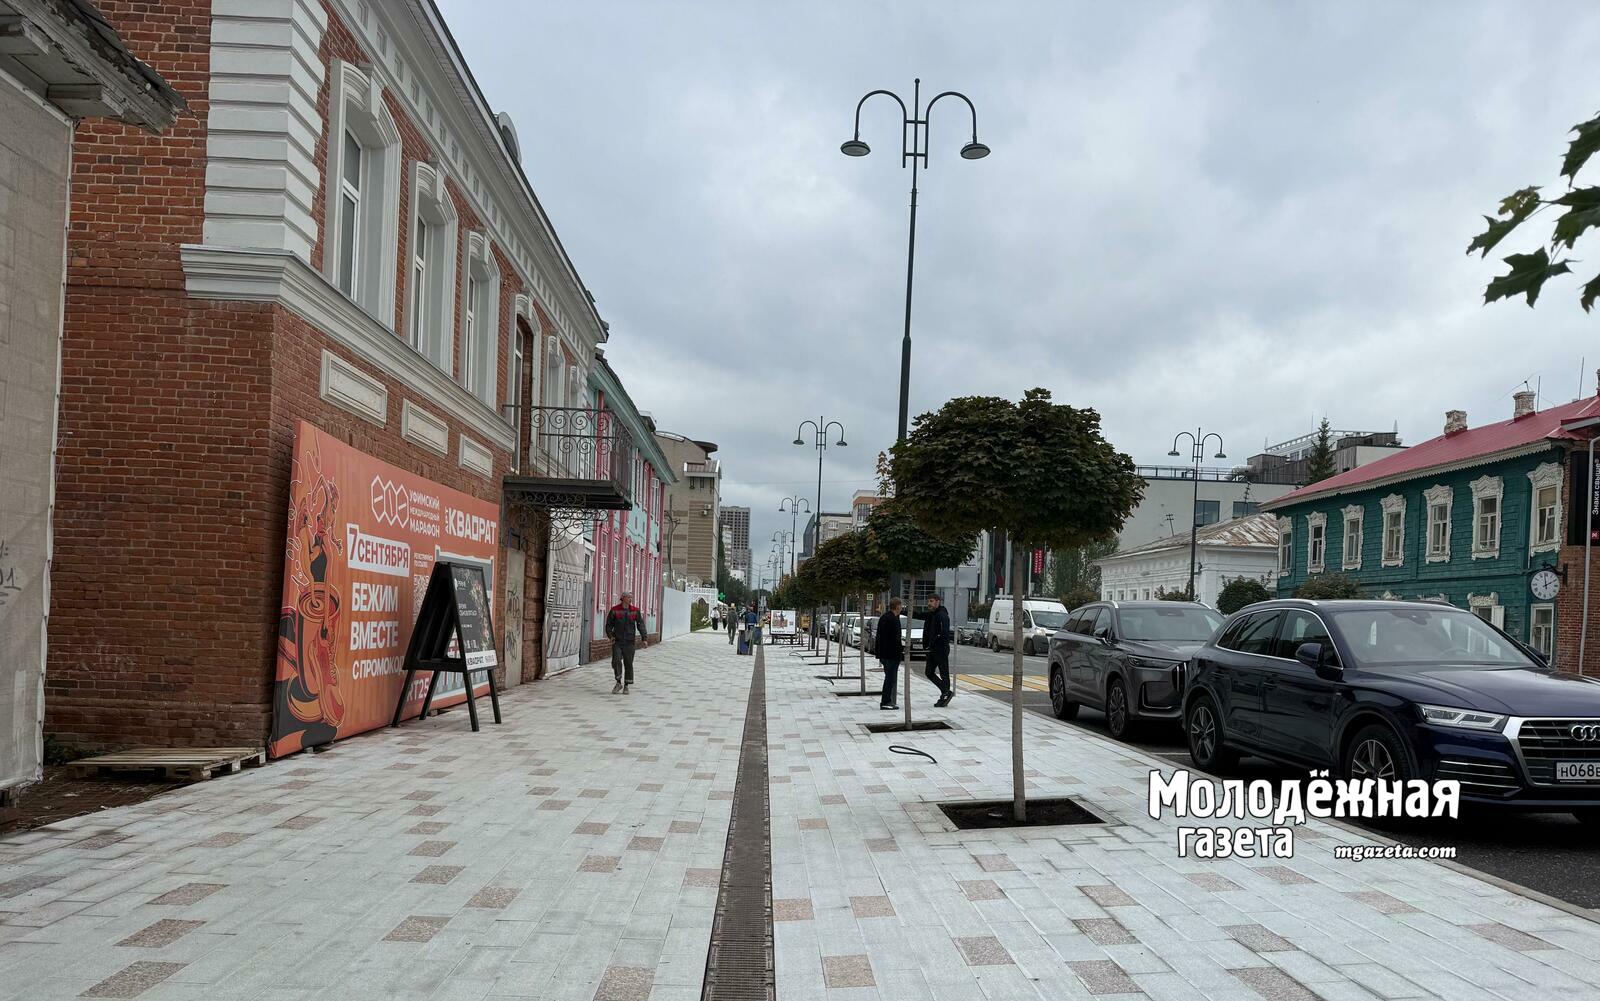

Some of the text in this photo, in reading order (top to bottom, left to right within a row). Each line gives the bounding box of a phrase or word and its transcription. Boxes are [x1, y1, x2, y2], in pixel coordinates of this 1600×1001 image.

[409, 489, 440, 510] УФИМСКИЙ
[409, 518, 440, 538] МАРАФОН
[448, 507, 497, 545] КВАДРАТ
[348, 527, 409, 568] 7 СЕНТЯБРЯ
[351, 582, 399, 612] БЕЖИМ
[350, 620, 399, 651] ВМЕСТЕ
[359, 655, 407, 679] ПРОМОКОД
